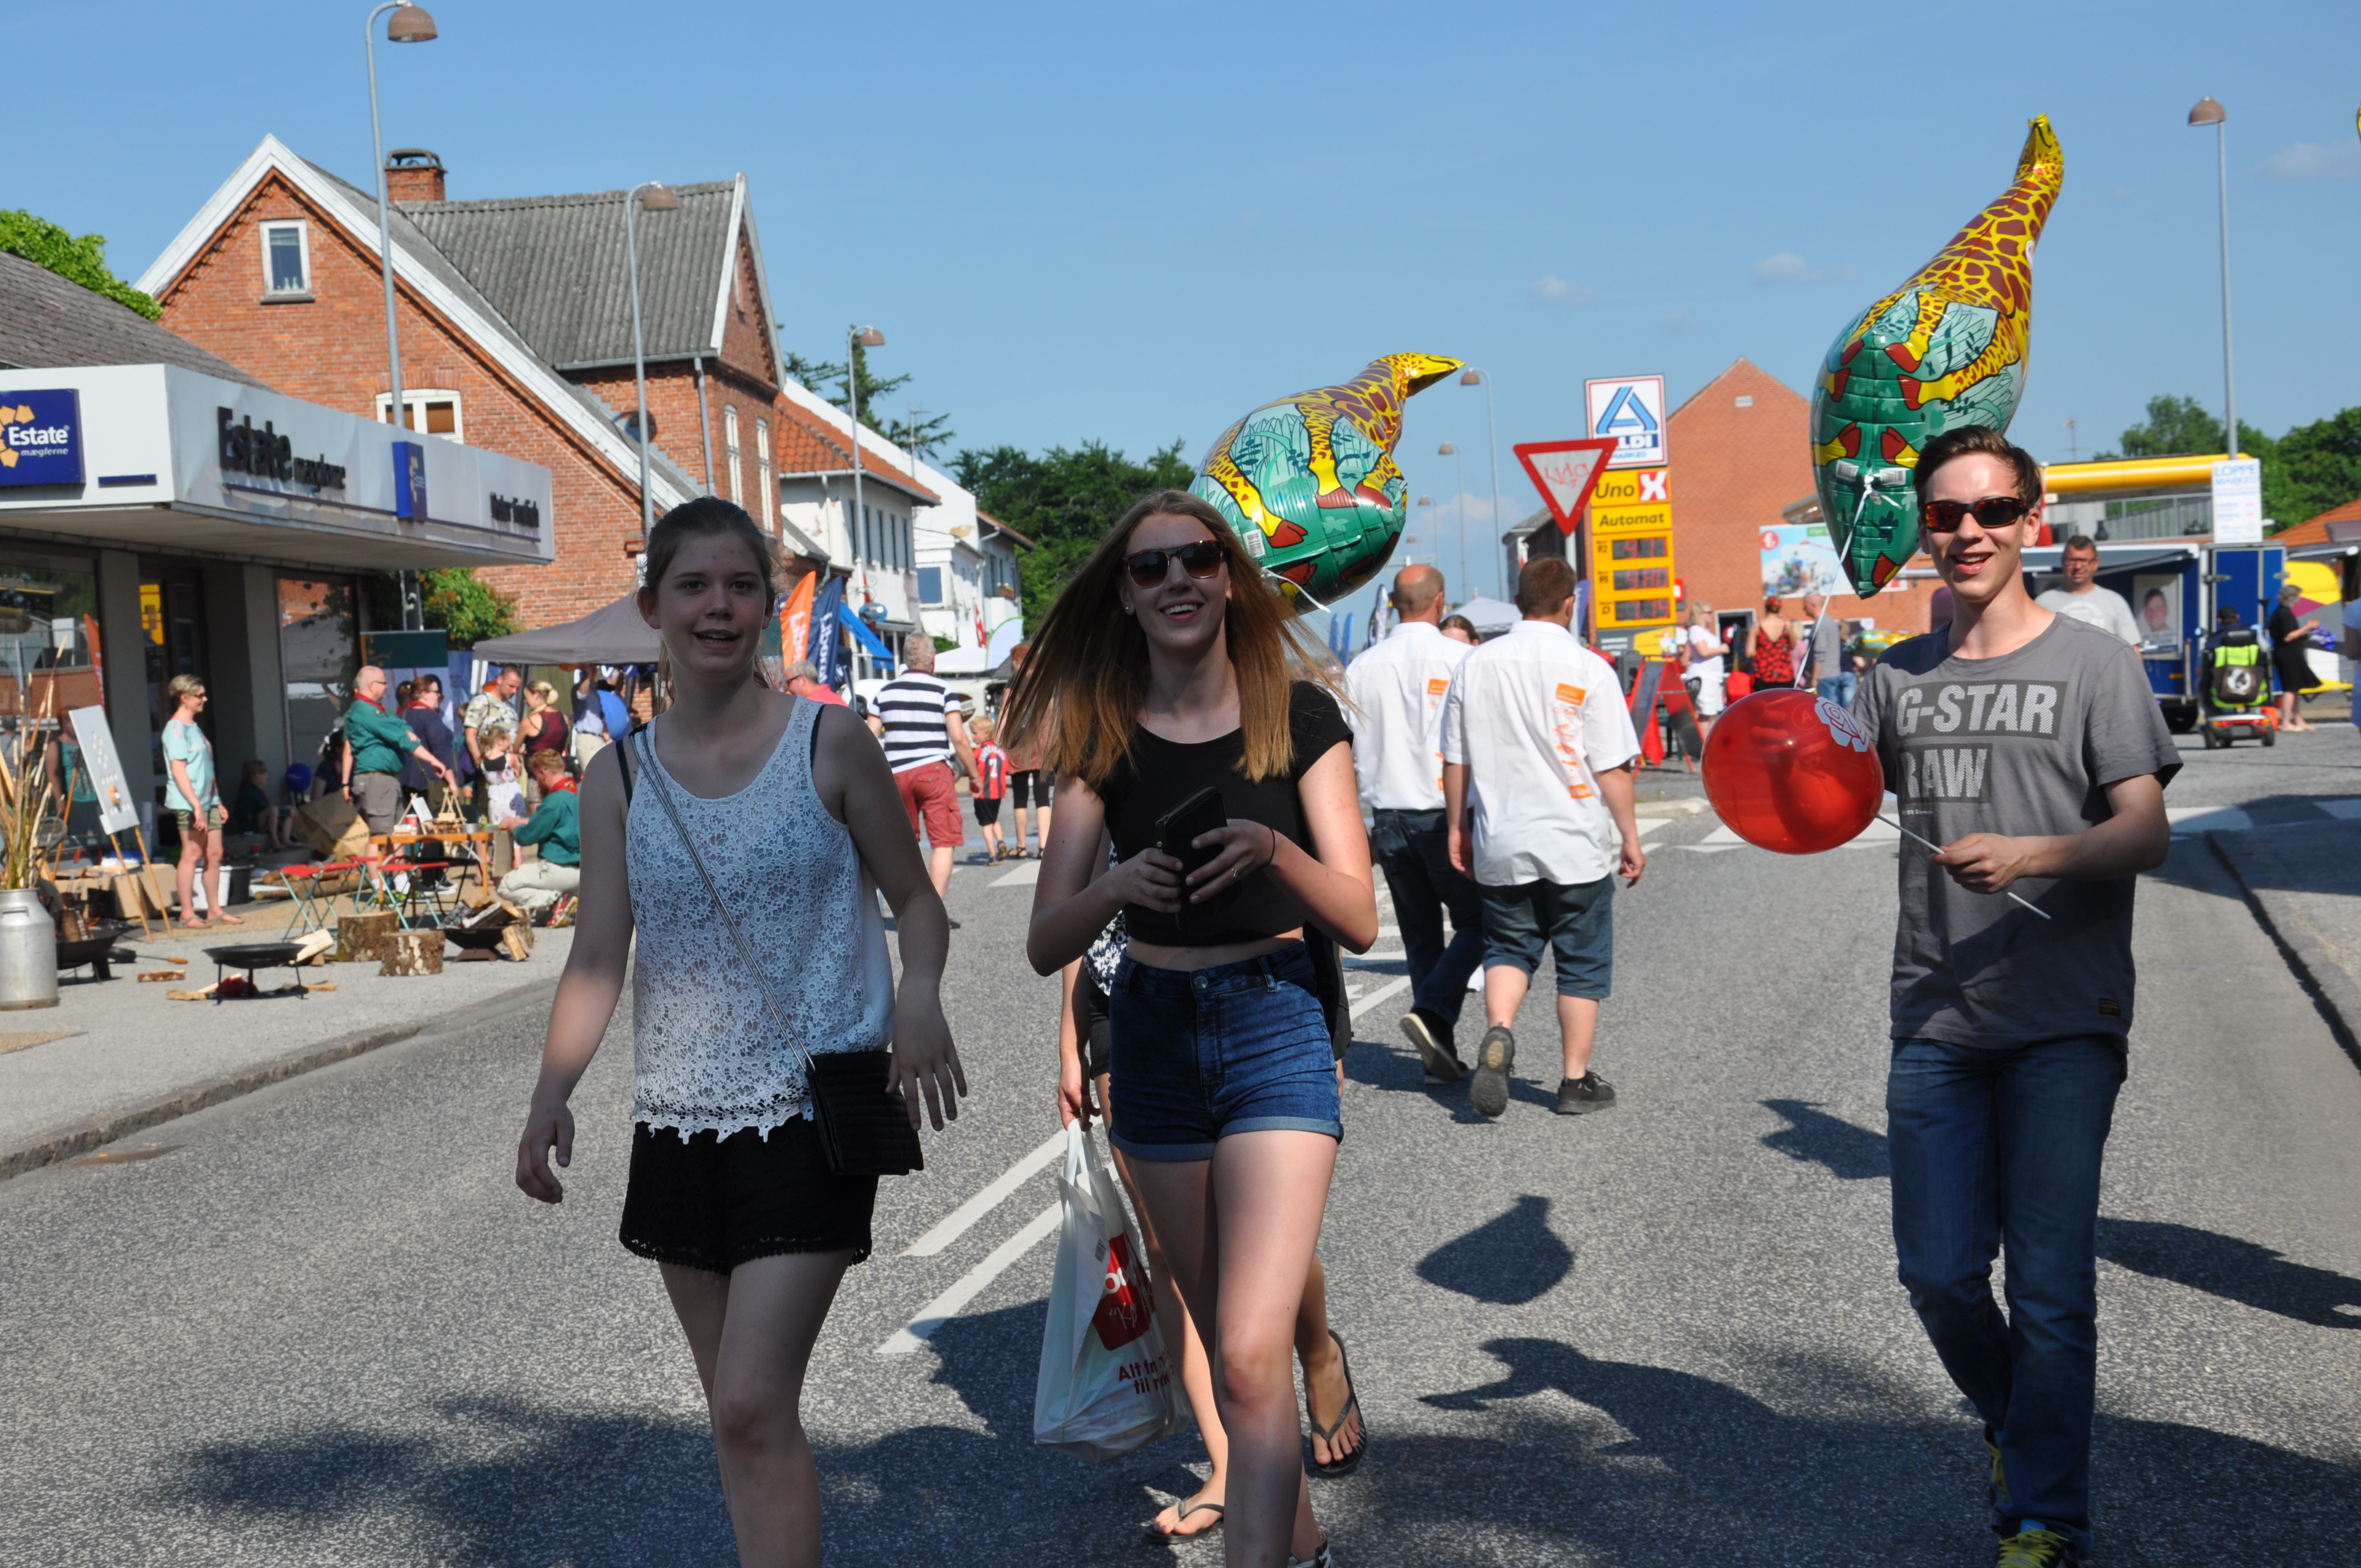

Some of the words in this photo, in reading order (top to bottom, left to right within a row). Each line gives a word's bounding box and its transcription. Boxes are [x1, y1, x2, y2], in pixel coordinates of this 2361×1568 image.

[8, 426, 68, 446] Estate
[217, 406, 292, 482] Estate
[1617, 433, 1653, 449] LDI
[20, 447, 68, 458] mæglerne
[2215, 465, 2255, 476] LOPPE
[1595, 482, 1635, 499] Uno
[1639, 470, 1667, 502] X
[1600, 513, 1664, 527] Automat
[1896, 684, 2057, 736] G-STAR
[1119, 1362, 1141, 1382] Alt
[1134, 1378, 1150, 1395] til
